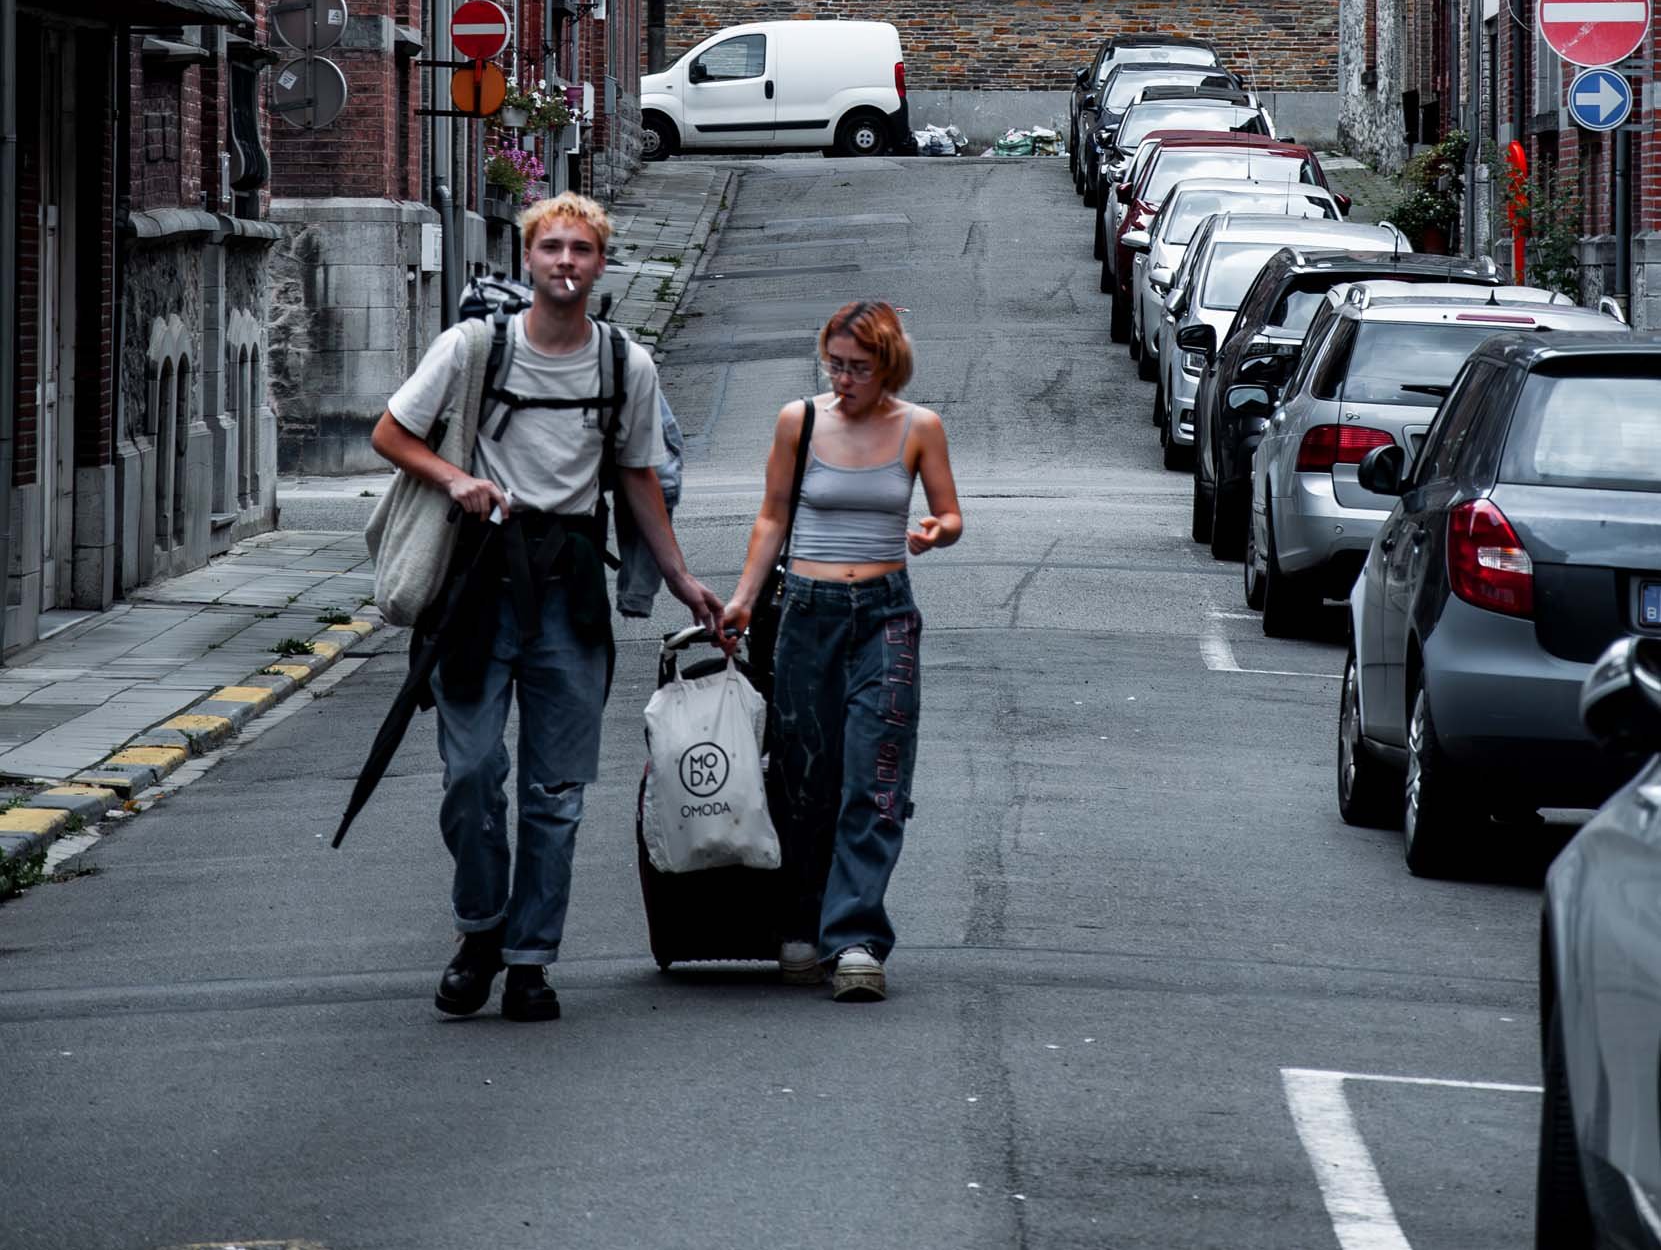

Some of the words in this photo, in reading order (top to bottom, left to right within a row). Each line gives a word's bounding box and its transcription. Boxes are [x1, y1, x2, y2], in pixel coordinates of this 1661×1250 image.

[1647, 606, 1657, 619] B
[690, 752, 718, 770] MO
[690, 770, 718, 787] DA
[680, 802, 732, 818] OMODA
